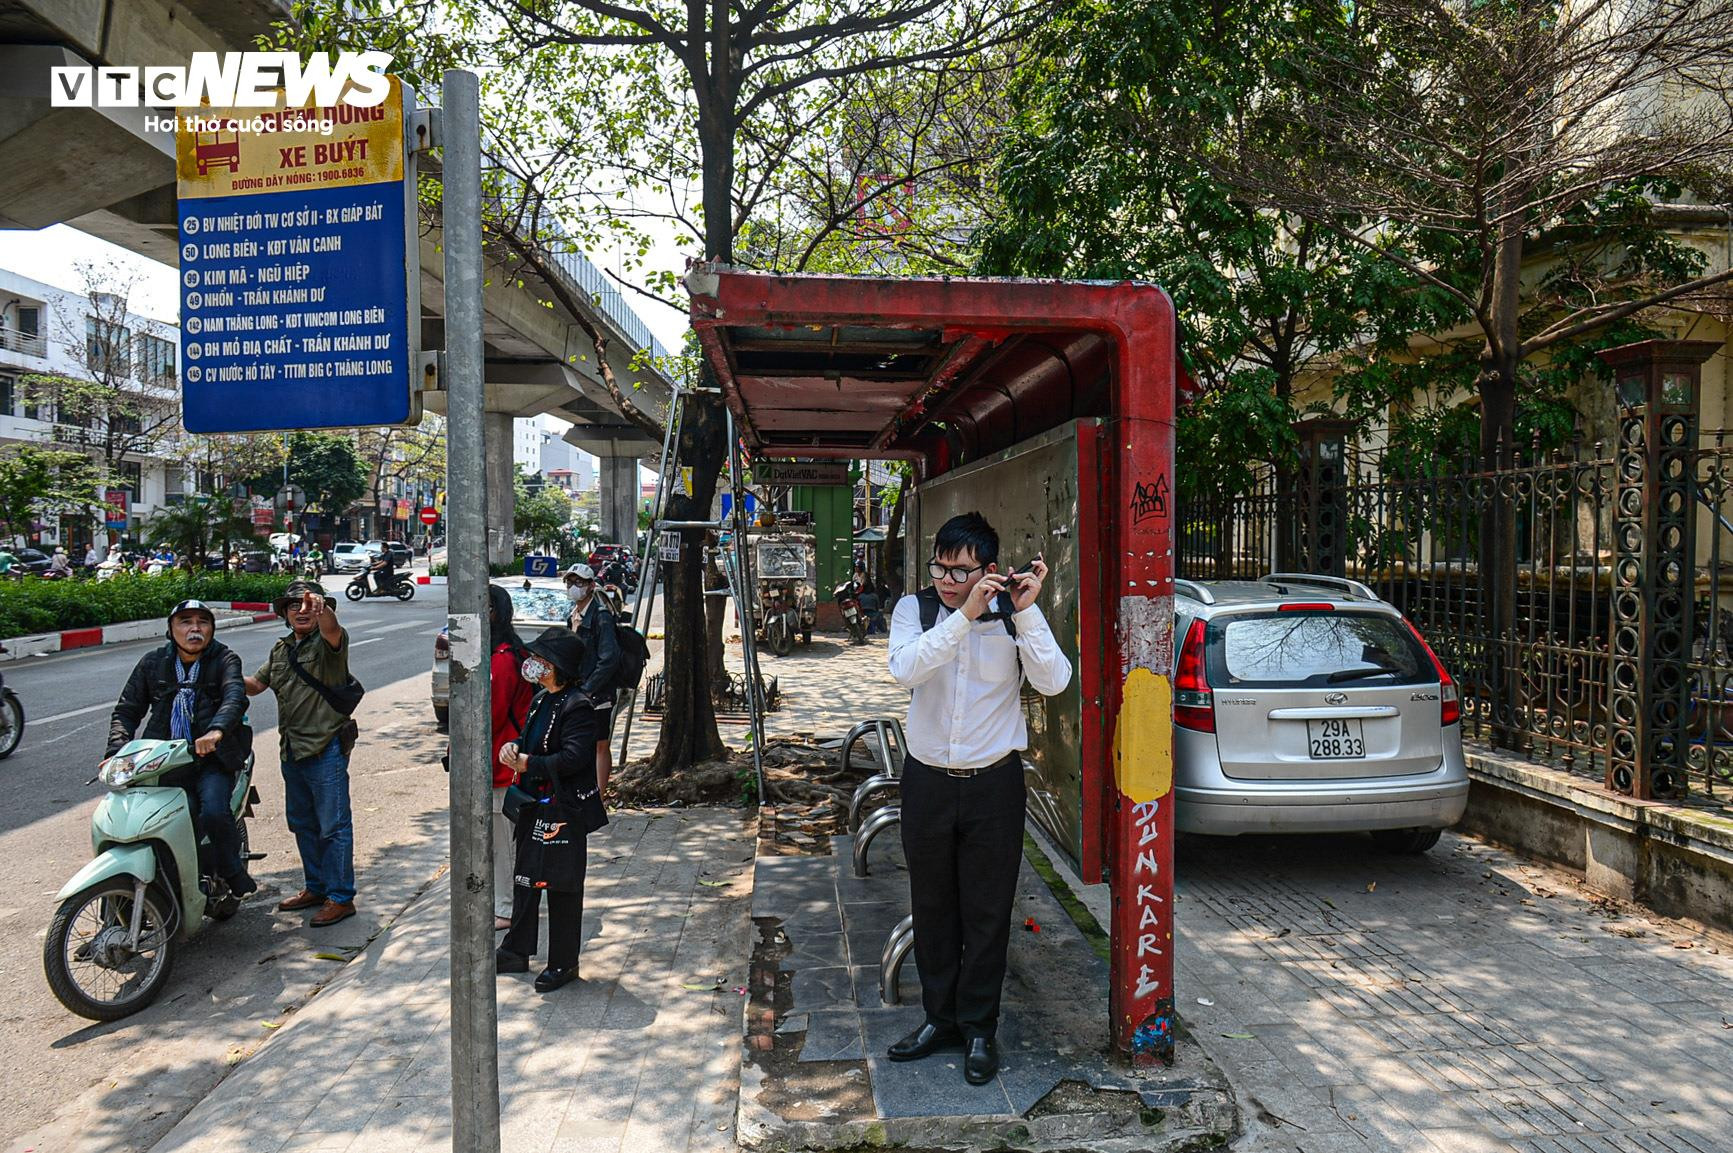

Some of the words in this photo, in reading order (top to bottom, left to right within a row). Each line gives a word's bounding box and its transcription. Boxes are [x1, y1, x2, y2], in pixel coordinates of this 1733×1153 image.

[279, 146, 307, 169] XE
[314, 132, 369, 165] BUÝT
[266, 174, 283, 188] DÂY
[318, 166, 365, 182] 1900.6836
[186, 219, 197, 231] 25
[203, 217, 215, 232] BV
[217, 212, 244, 234] NHIỆT
[264, 213, 279, 229] TW
[281, 211, 295, 228] CƠ
[296, 204, 310, 226] SỞ
[311, 210, 318, 226] II
[326, 208, 339, 224] BX
[341, 203, 363, 223] GIÁP
[365, 200, 383, 220] BÁT
[185, 246, 196, 258] 50
[203, 243, 231, 259] LONG
[233, 238, 258, 257] BIÊN
[267, 240, 287, 256] KĐT
[289, 235, 310, 254] VÂN
[313, 235, 341, 253] CANH
[186, 272, 197, 284] 99
[204, 270, 226, 286] KIM
[229, 265, 247, 284] MÃ
[258, 263, 281, 283] NGŨ
[284, 262, 310, 283] HIỆP
[189, 294, 200, 306] 49
[204, 286, 233, 307] NHỔN
[310, 286, 326, 302] DƯ
[204, 317, 224, 333] NAM
[225, 313, 254, 331] THĂNG
[255, 314, 278, 330] LONG
[285, 313, 302, 329] KĐT
[304, 311, 338, 328] VINCOM
[340, 309, 362, 326] LONG
[364, 305, 385, 324] BIÊN
[205, 342, 220, 357] ĐH
[223, 336, 240, 356] MỎ
[264, 334, 292, 354] CHẤT
[374, 333, 391, 350] DƯ
[205, 367, 217, 382] CV
[219, 362, 244, 381] NƯỚC
[260, 362, 276, 380] TÂY
[284, 364, 306, 379] TTTM
[308, 363, 324, 378] BIG
[326, 362, 332, 377] C
[335, 358, 364, 377] THĂNG
[366, 360, 392, 376] LONG
[532, 558, 548, 575] G7
[1321, 719, 1350, 738] 29A
[1312, 738, 1363, 757] 288.33
